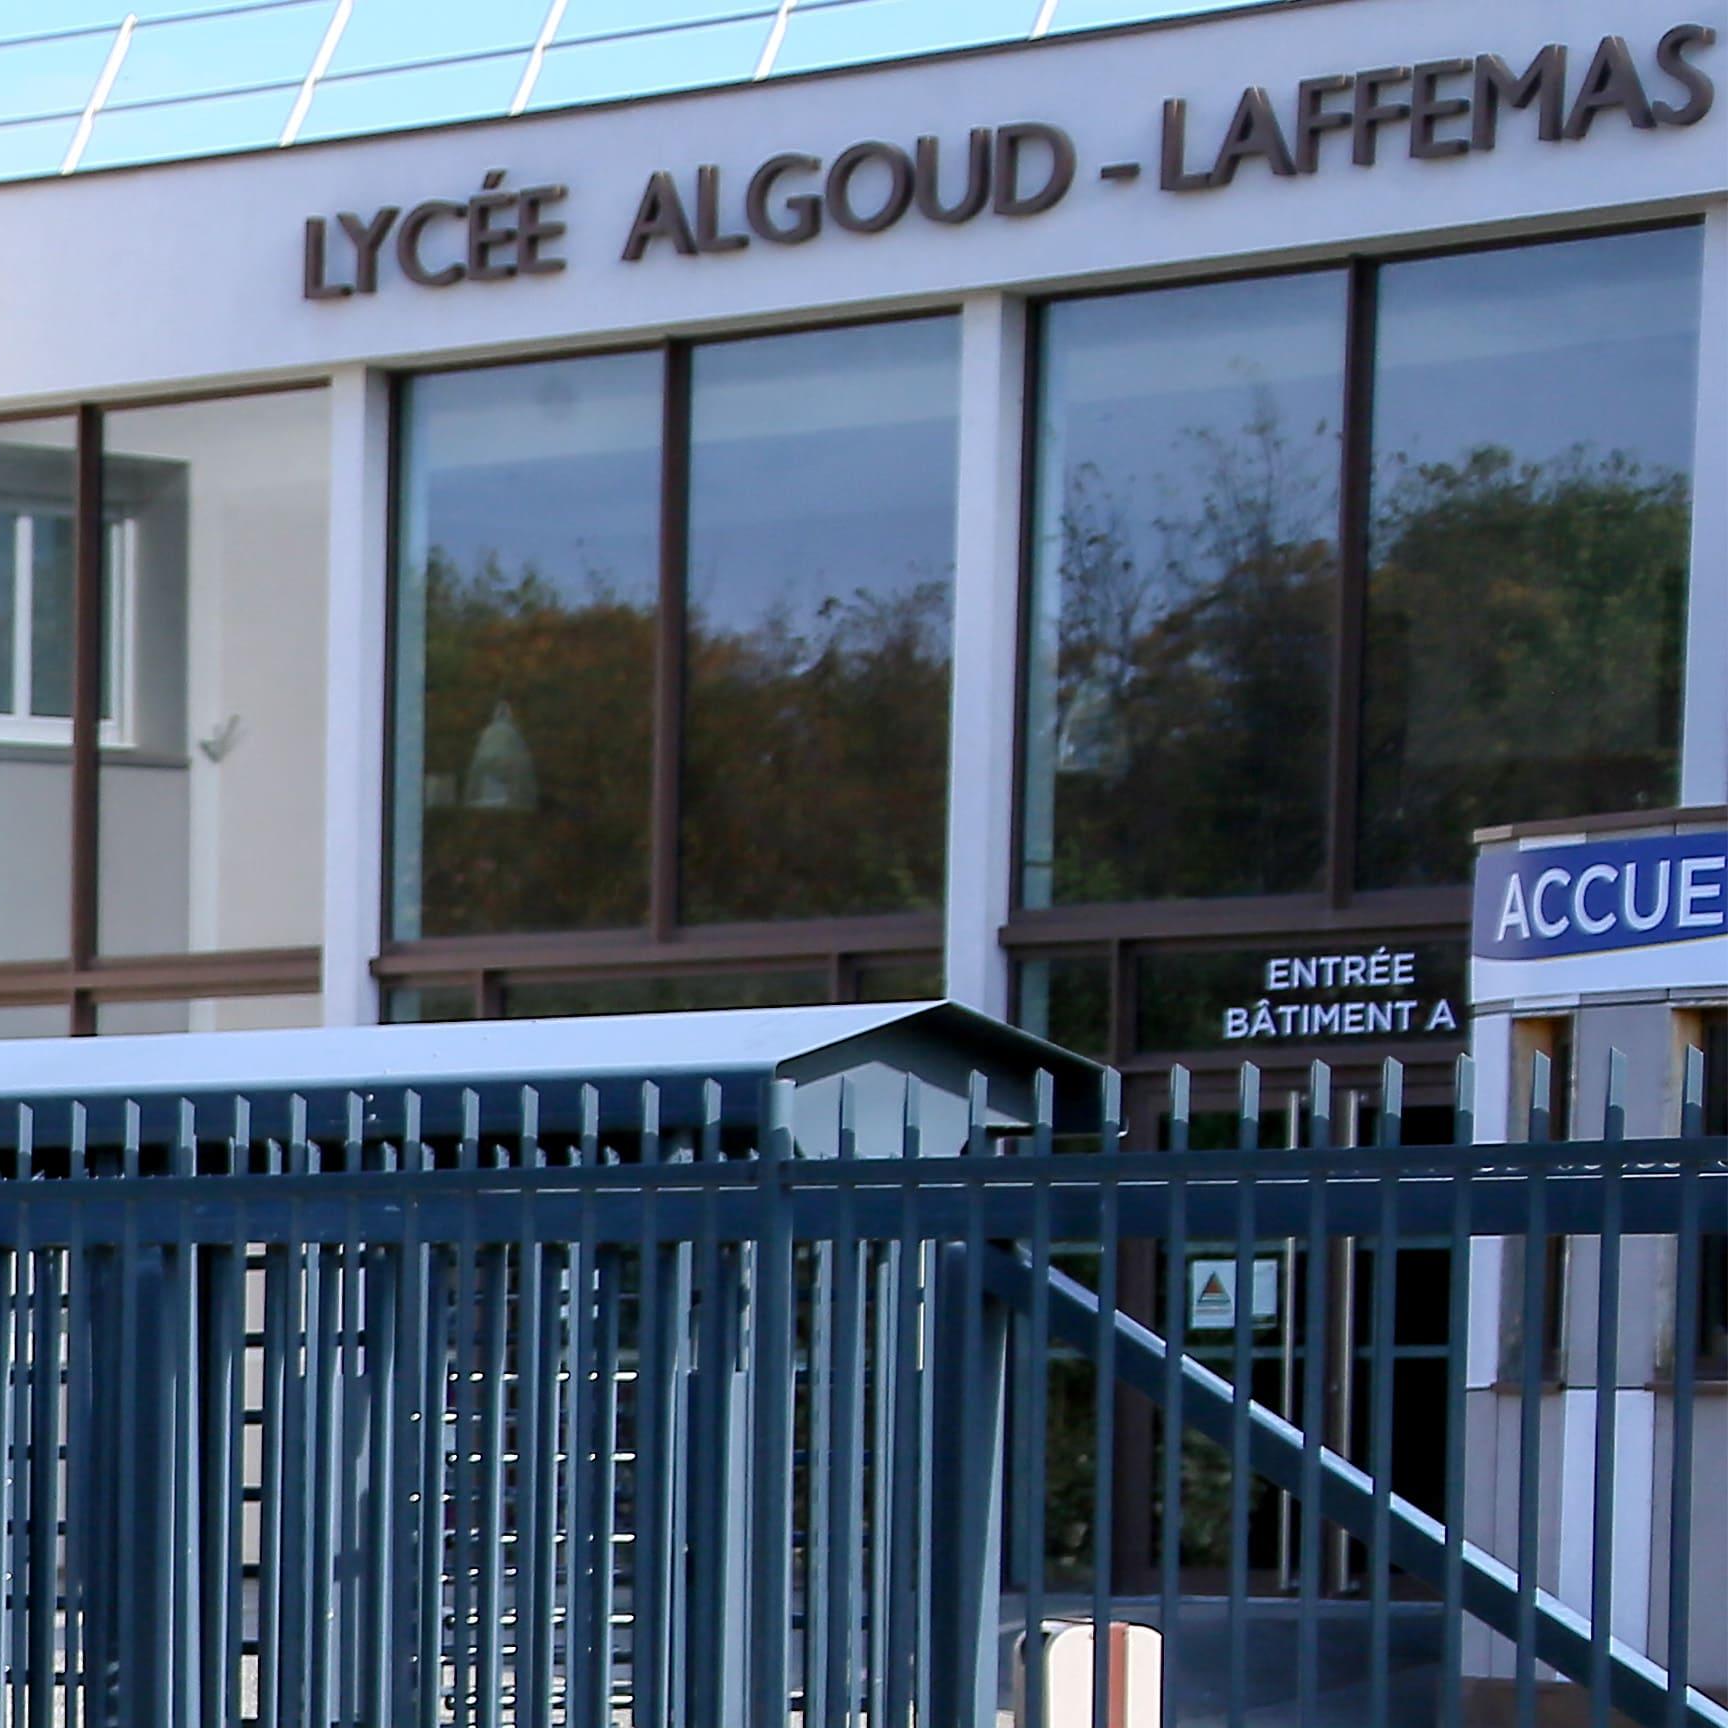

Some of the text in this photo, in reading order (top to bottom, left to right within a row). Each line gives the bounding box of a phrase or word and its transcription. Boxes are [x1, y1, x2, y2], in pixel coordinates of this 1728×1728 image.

[302, 170, 565, 300] LYCÉE
[1497, 857, 1727, 941] ACCUE
[1266, 947, 1416, 989] ENTRÉE
[1223, 999, 1456, 1039] BÂTIMENT A
